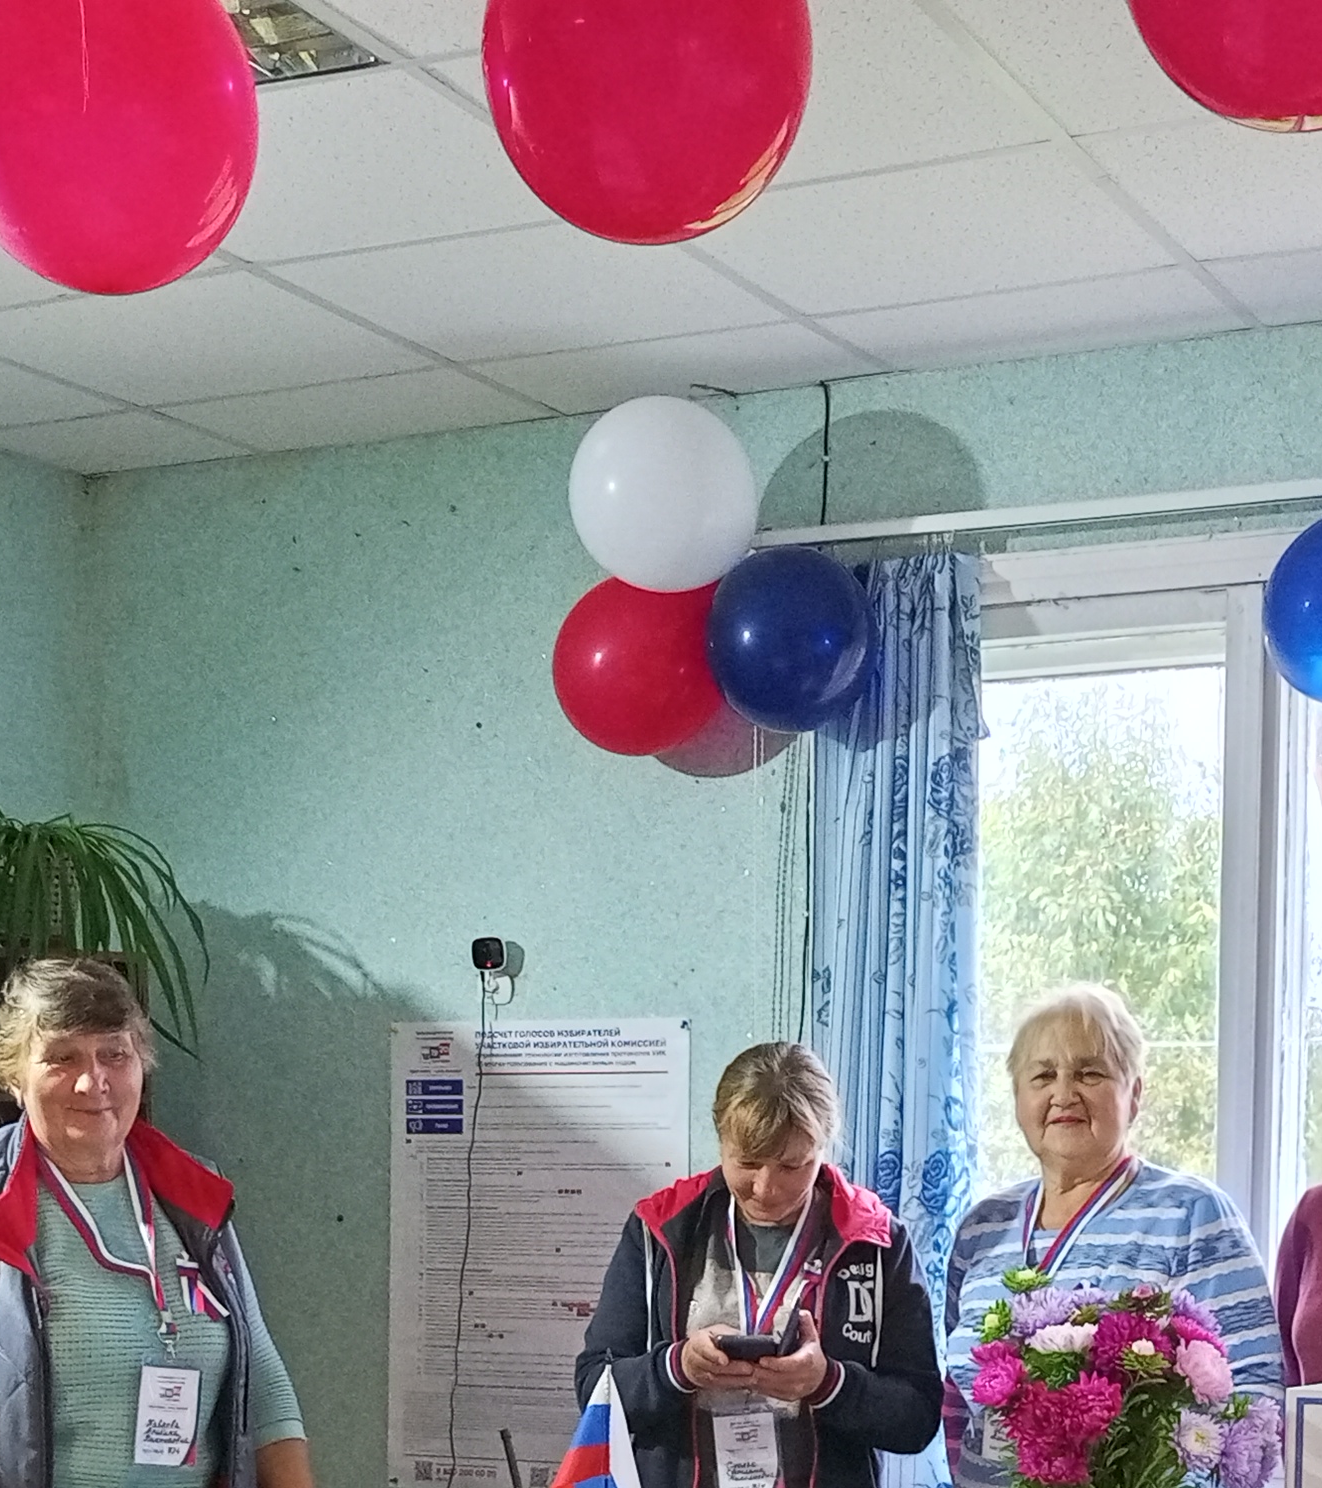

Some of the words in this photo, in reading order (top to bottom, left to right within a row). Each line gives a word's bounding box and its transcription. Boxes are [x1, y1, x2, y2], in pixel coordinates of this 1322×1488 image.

[514, 1029, 555, 1038] ГОЛОСОВ
[557, 1027, 621, 1038] ИЗБИРАТЕЛЕЙ
[533, 1038, 609, 1049] ИЗБИРАТЕЛЬНОЙ
[610, 1037, 667, 1048] КОМИССИЕЙ
